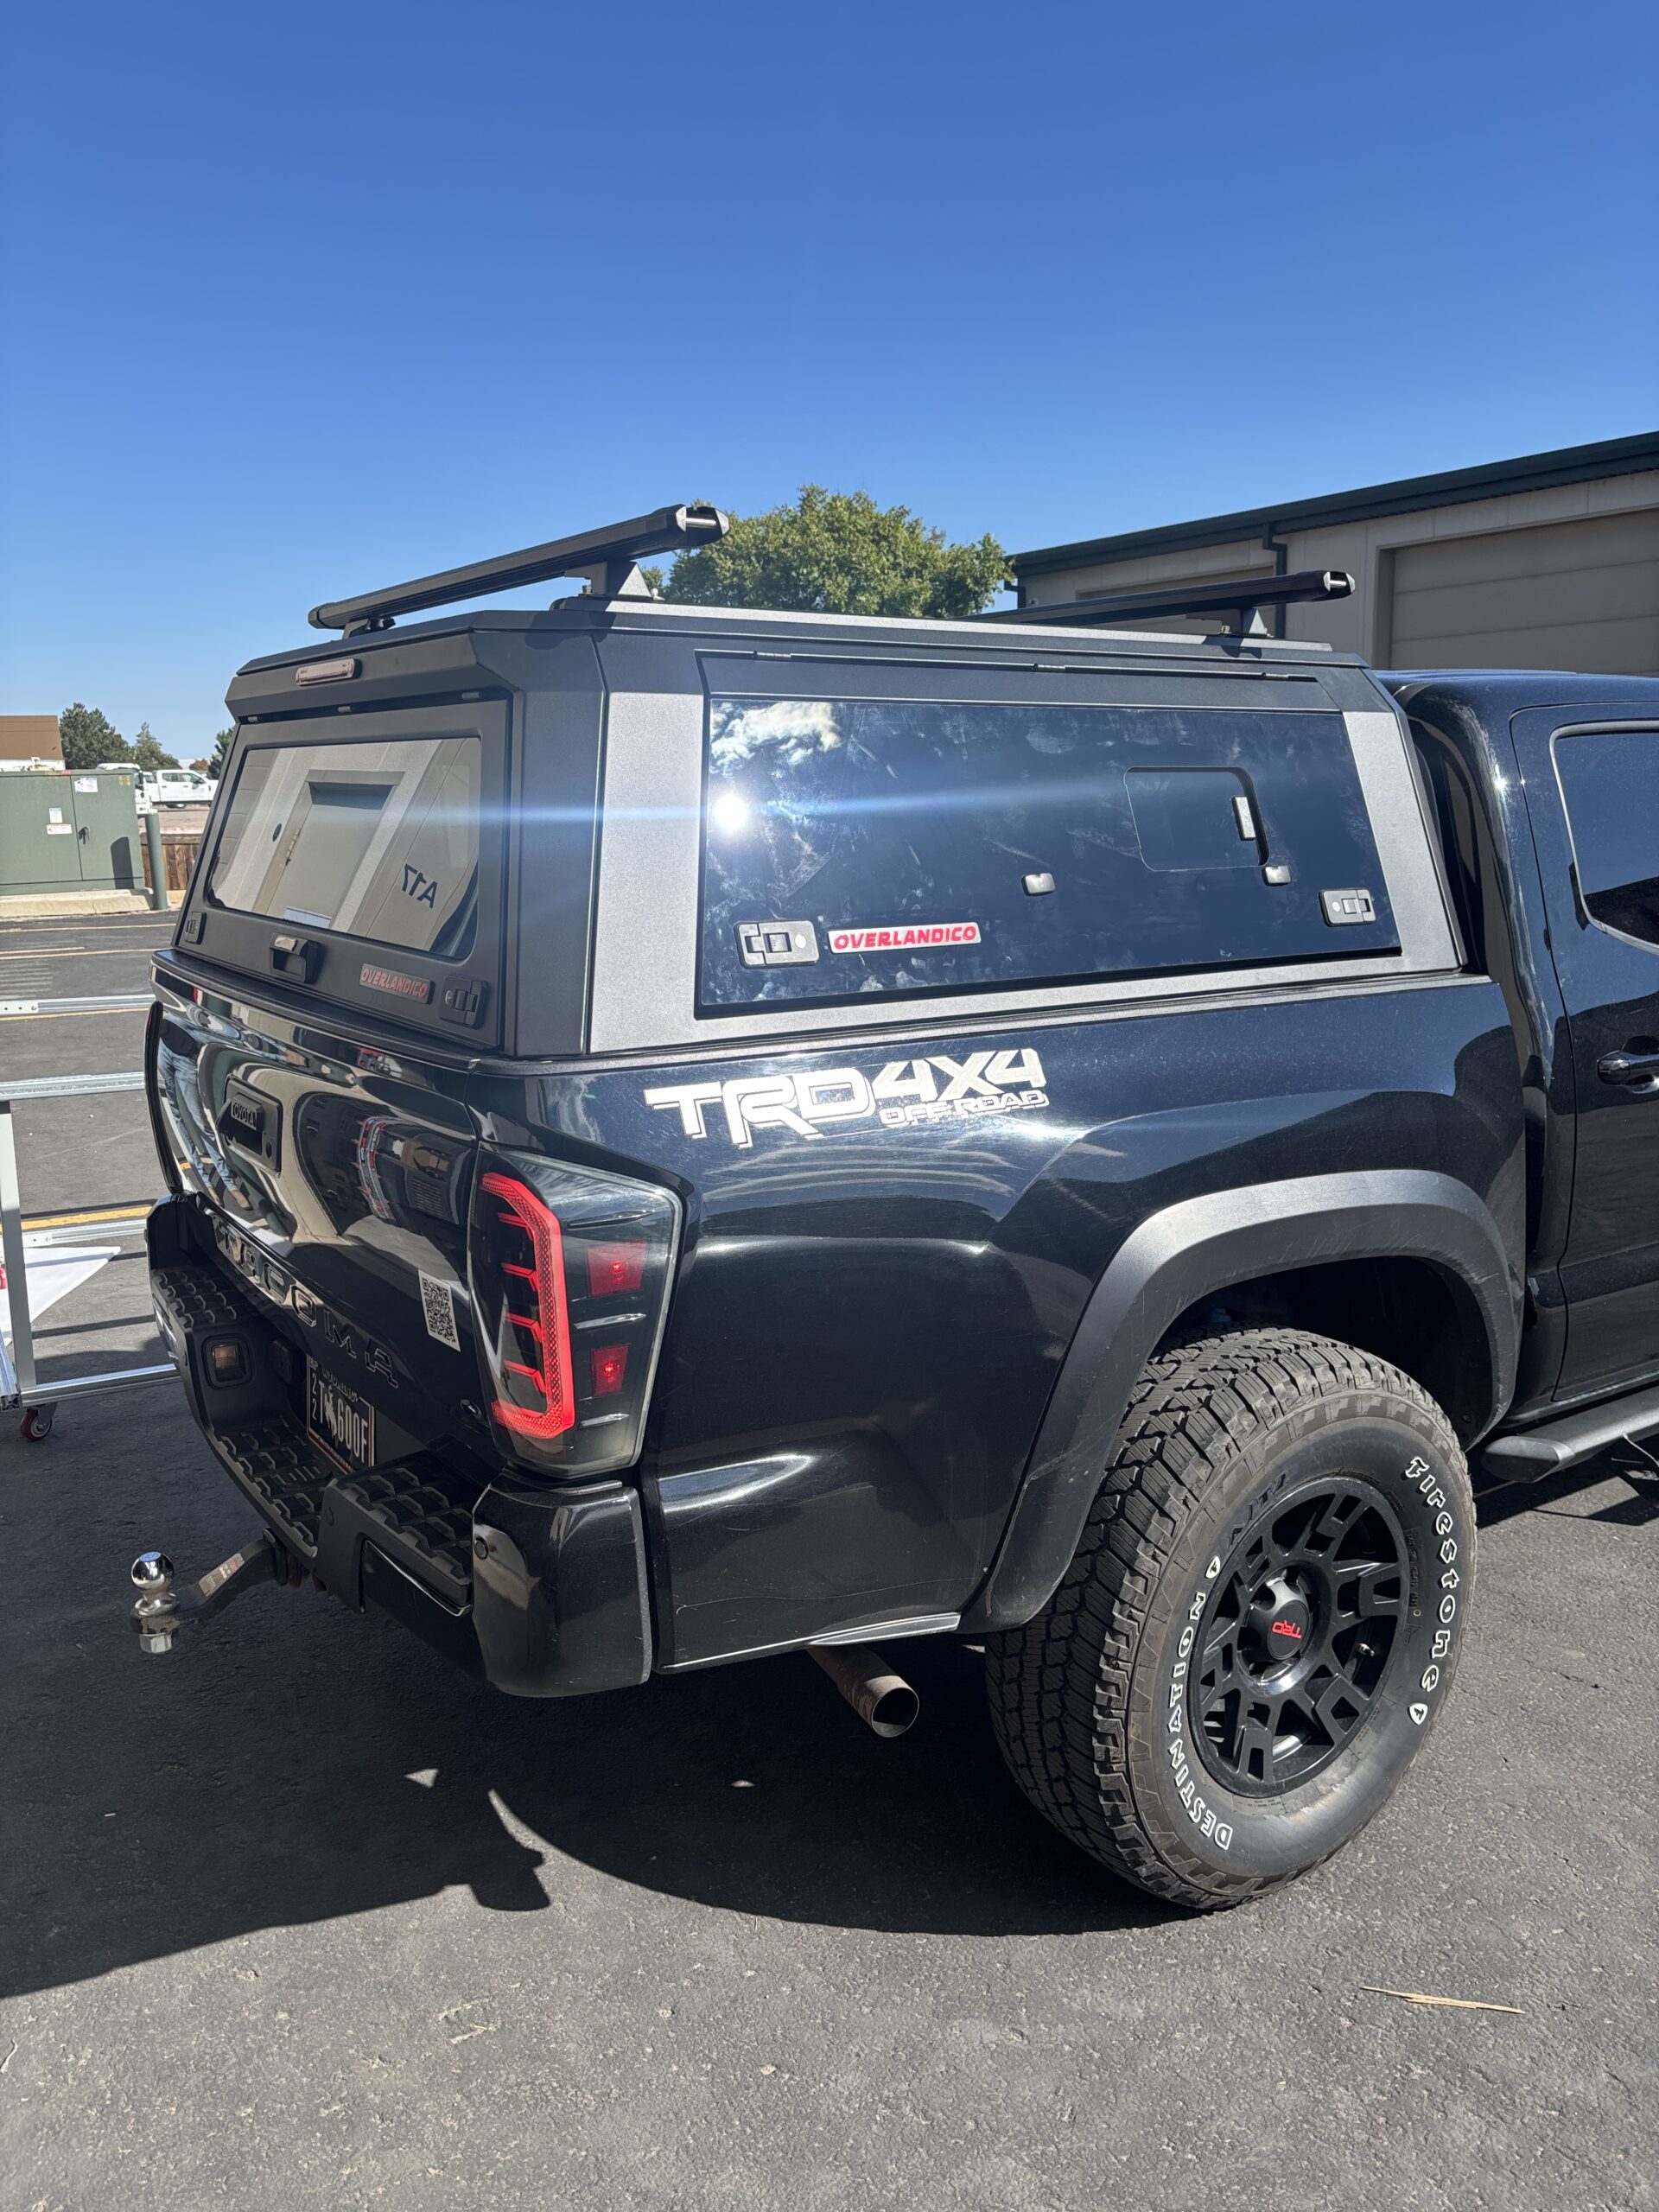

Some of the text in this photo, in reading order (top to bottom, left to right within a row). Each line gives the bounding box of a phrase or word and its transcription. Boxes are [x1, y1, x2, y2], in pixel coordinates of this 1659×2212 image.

[833, 925, 976, 950] OVERLANDICO
[361, 968, 429, 999] OVERLANDICO
[232, 1102, 257, 1128] TOYOTA
[644, 1048, 1046, 1149] TRD 4X4
[218, 1219, 398, 1389] TACOMA
[1406, 1457, 1458, 1692] Firestone
[1272, 1619, 1302, 1639] TRD
[1169, 1592, 1233, 1851] DESTINATION
